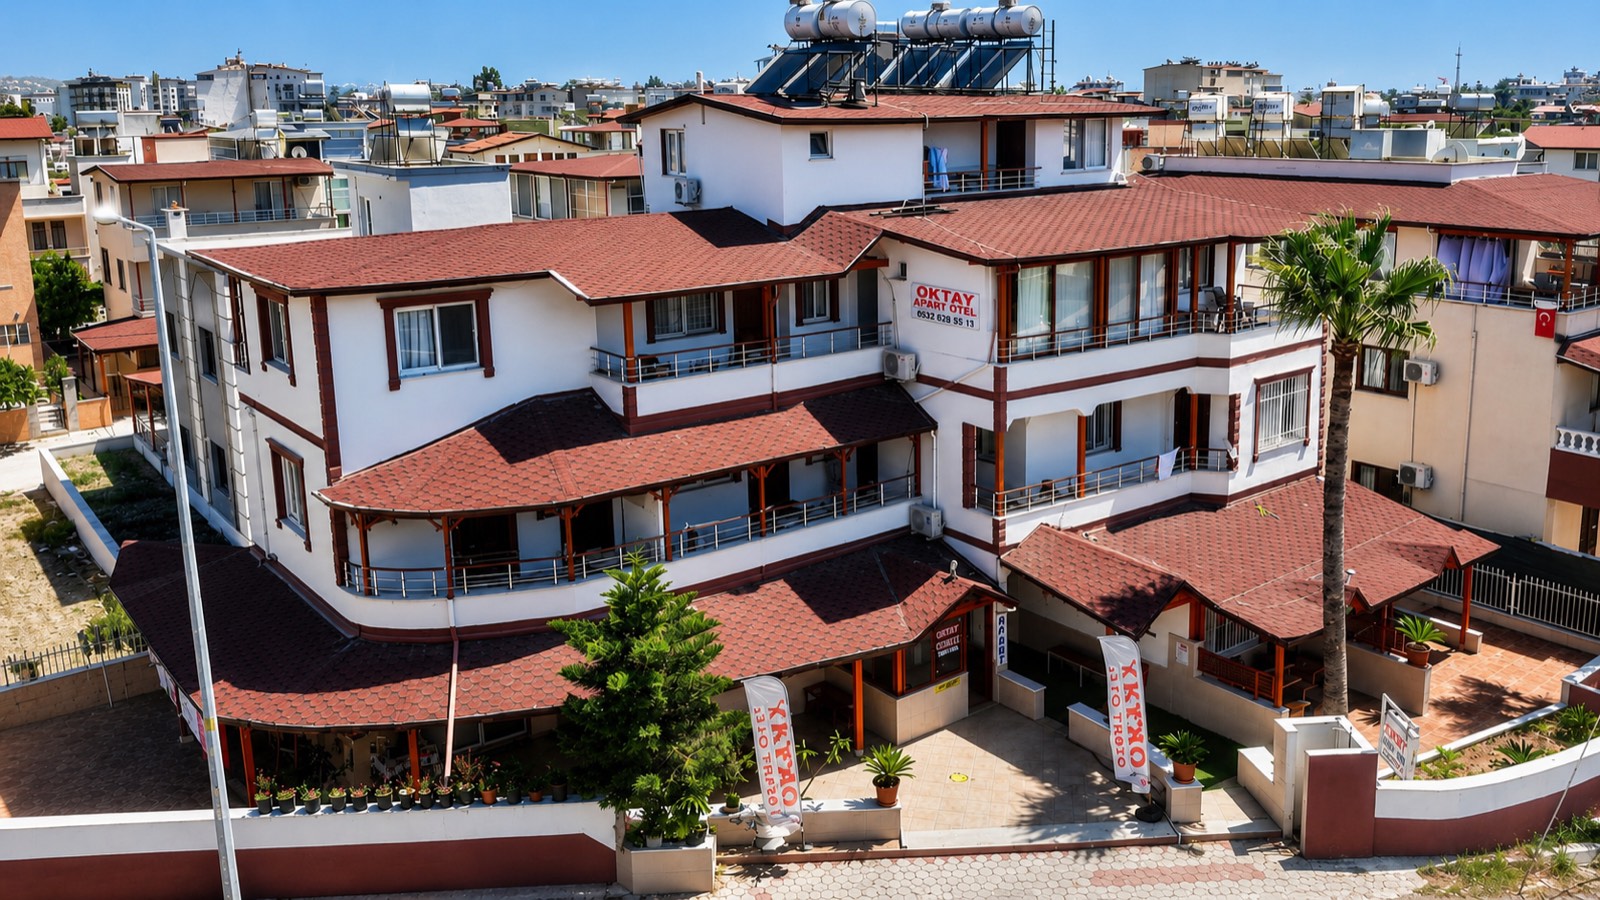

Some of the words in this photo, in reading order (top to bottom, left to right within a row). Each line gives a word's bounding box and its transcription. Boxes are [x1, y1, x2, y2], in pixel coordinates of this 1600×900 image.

[917, 285, 974, 306] OKTAY
[913, 298, 946, 311] APART
[950, 305, 977, 317] OTEL
[966, 319, 974, 327] 13
